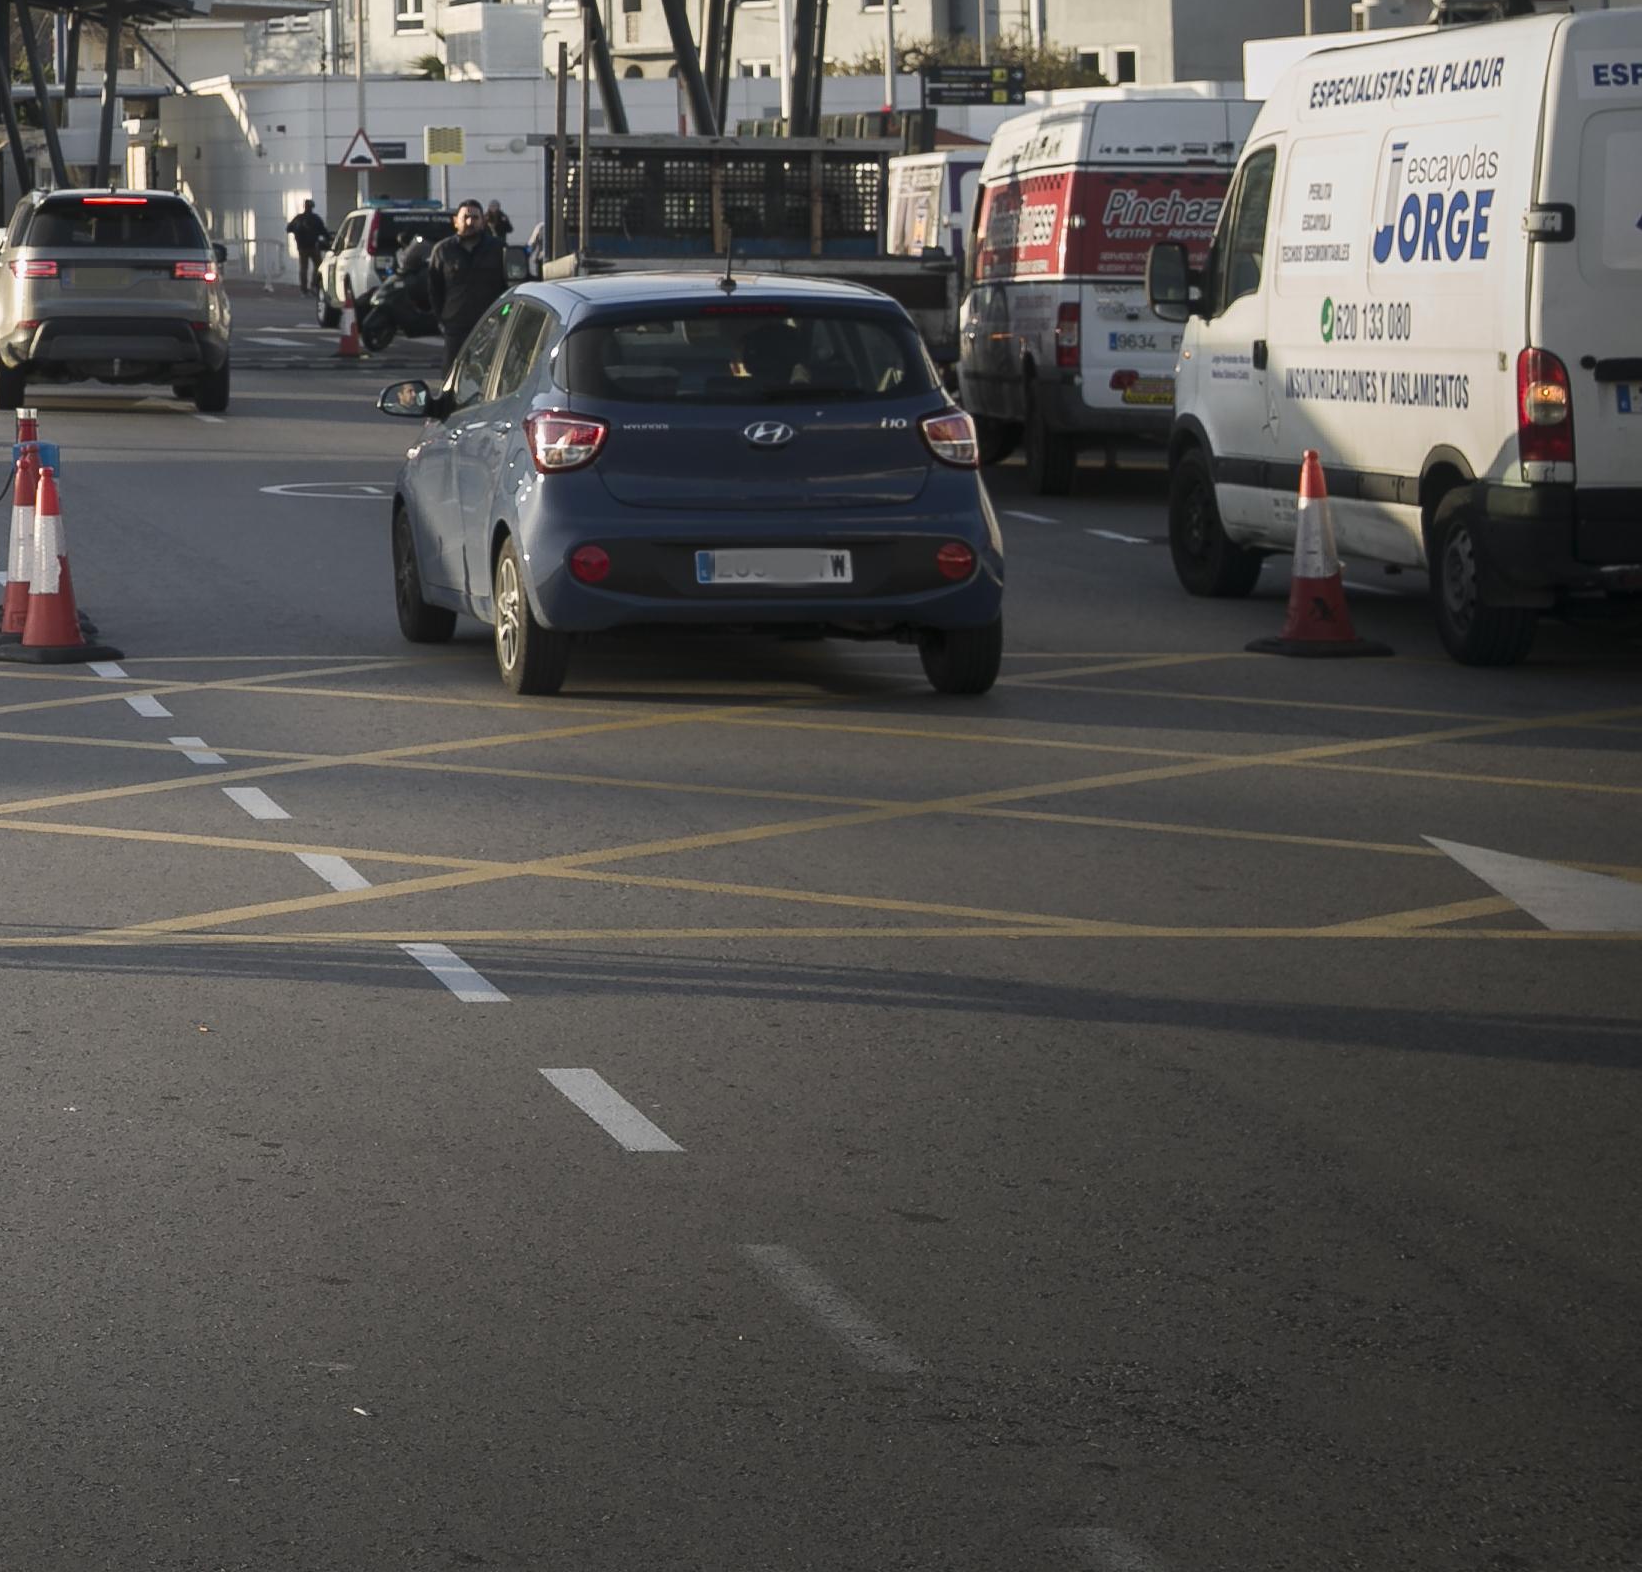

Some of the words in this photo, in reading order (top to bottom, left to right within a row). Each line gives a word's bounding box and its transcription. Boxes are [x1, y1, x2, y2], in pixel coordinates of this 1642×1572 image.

[1309, 68, 1415, 110] ESPECIALISTAS
[1416, 64, 1440, 96] EN
[1440, 56, 1505, 93] PLADUR
[1407, 143, 1499, 191] escayolas
[1373, 142, 1495, 263] JORGE
[1105, 228, 1152, 239] VENTA
[1336, 304, 1358, 340] 620
[1362, 303, 1384, 340] 133
[1388, 302, 1411, 340] 080
[1117, 334, 1157, 349] 9634
[1379, 371, 1388, 404] Y
[1390, 371, 1470, 409] AISLAMIENTOS
[880, 417, 907, 429] i10
